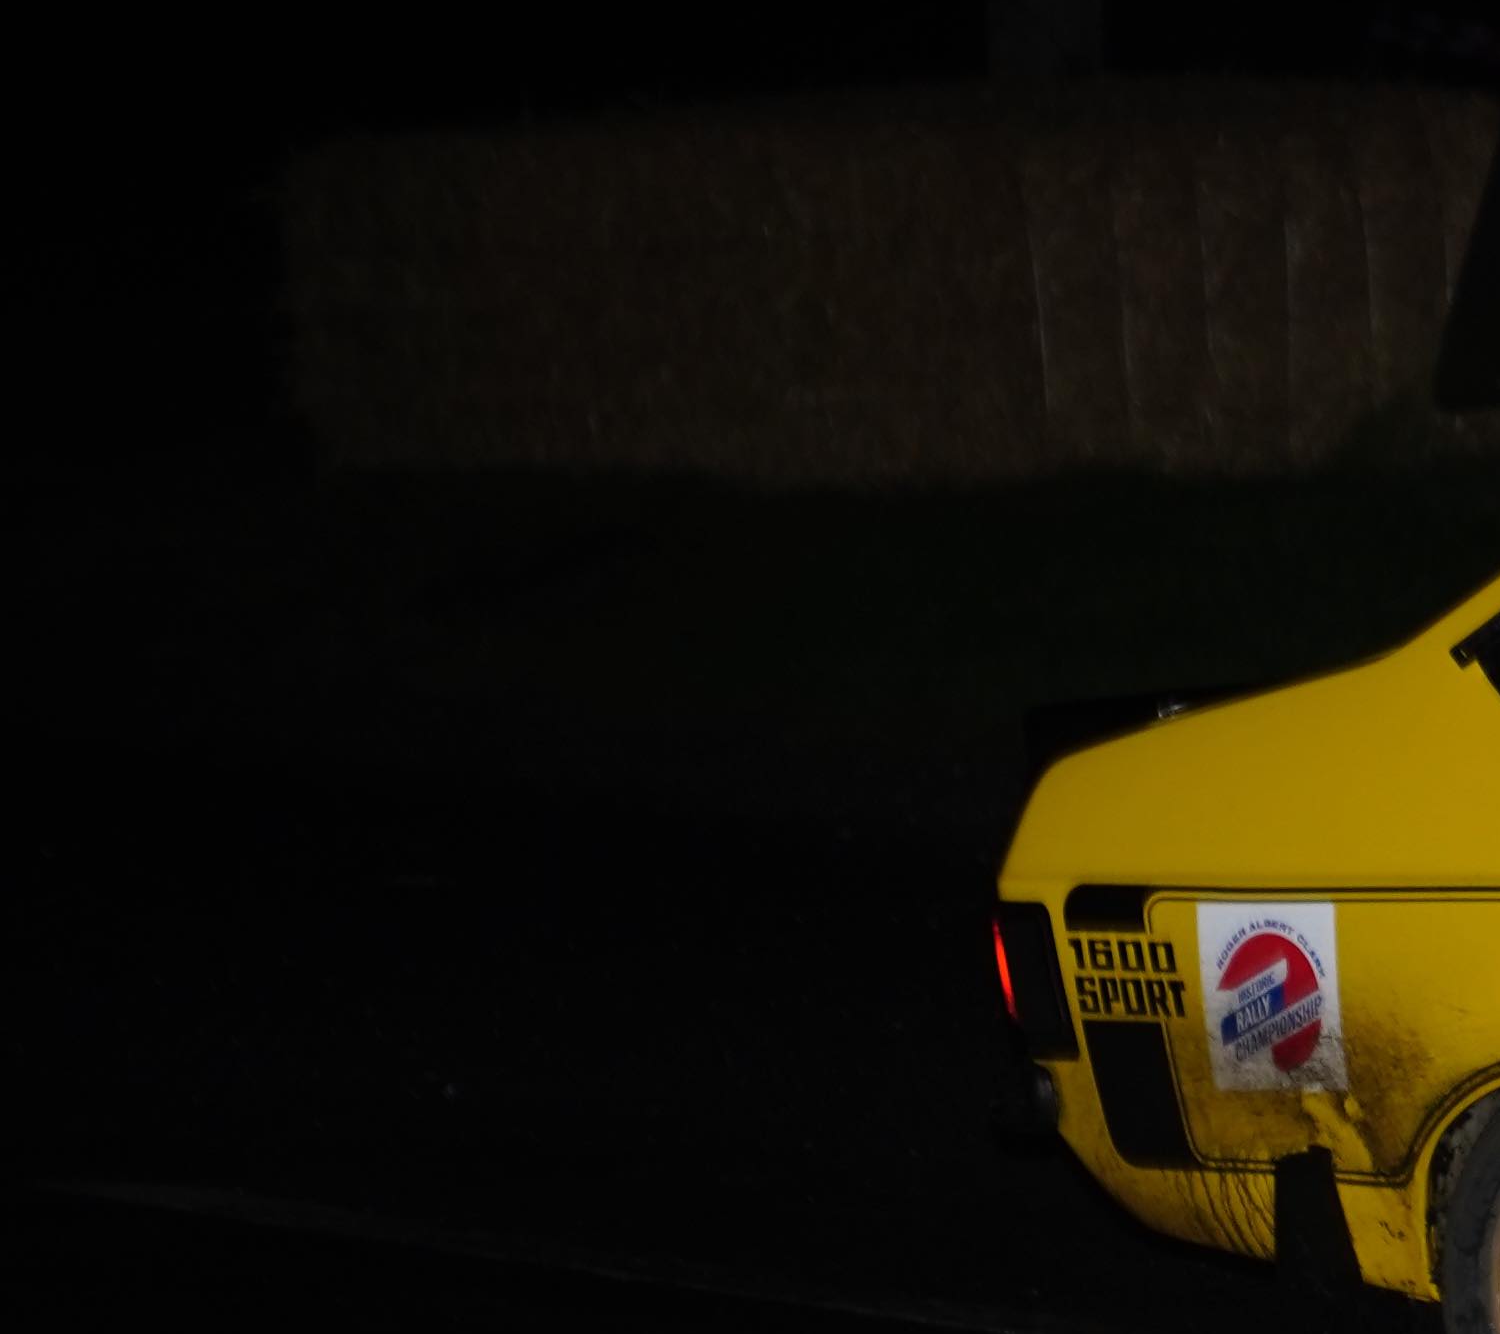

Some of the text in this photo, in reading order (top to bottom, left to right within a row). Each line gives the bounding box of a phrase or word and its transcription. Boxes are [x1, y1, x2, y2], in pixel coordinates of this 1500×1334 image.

[1067, 939, 1178, 973] 1600
[1074, 975, 1187, 1018] SPORT
[1235, 994, 1272, 1031] RALLY
[1235, 995, 1323, 1061] CHAMPIONSHIP
